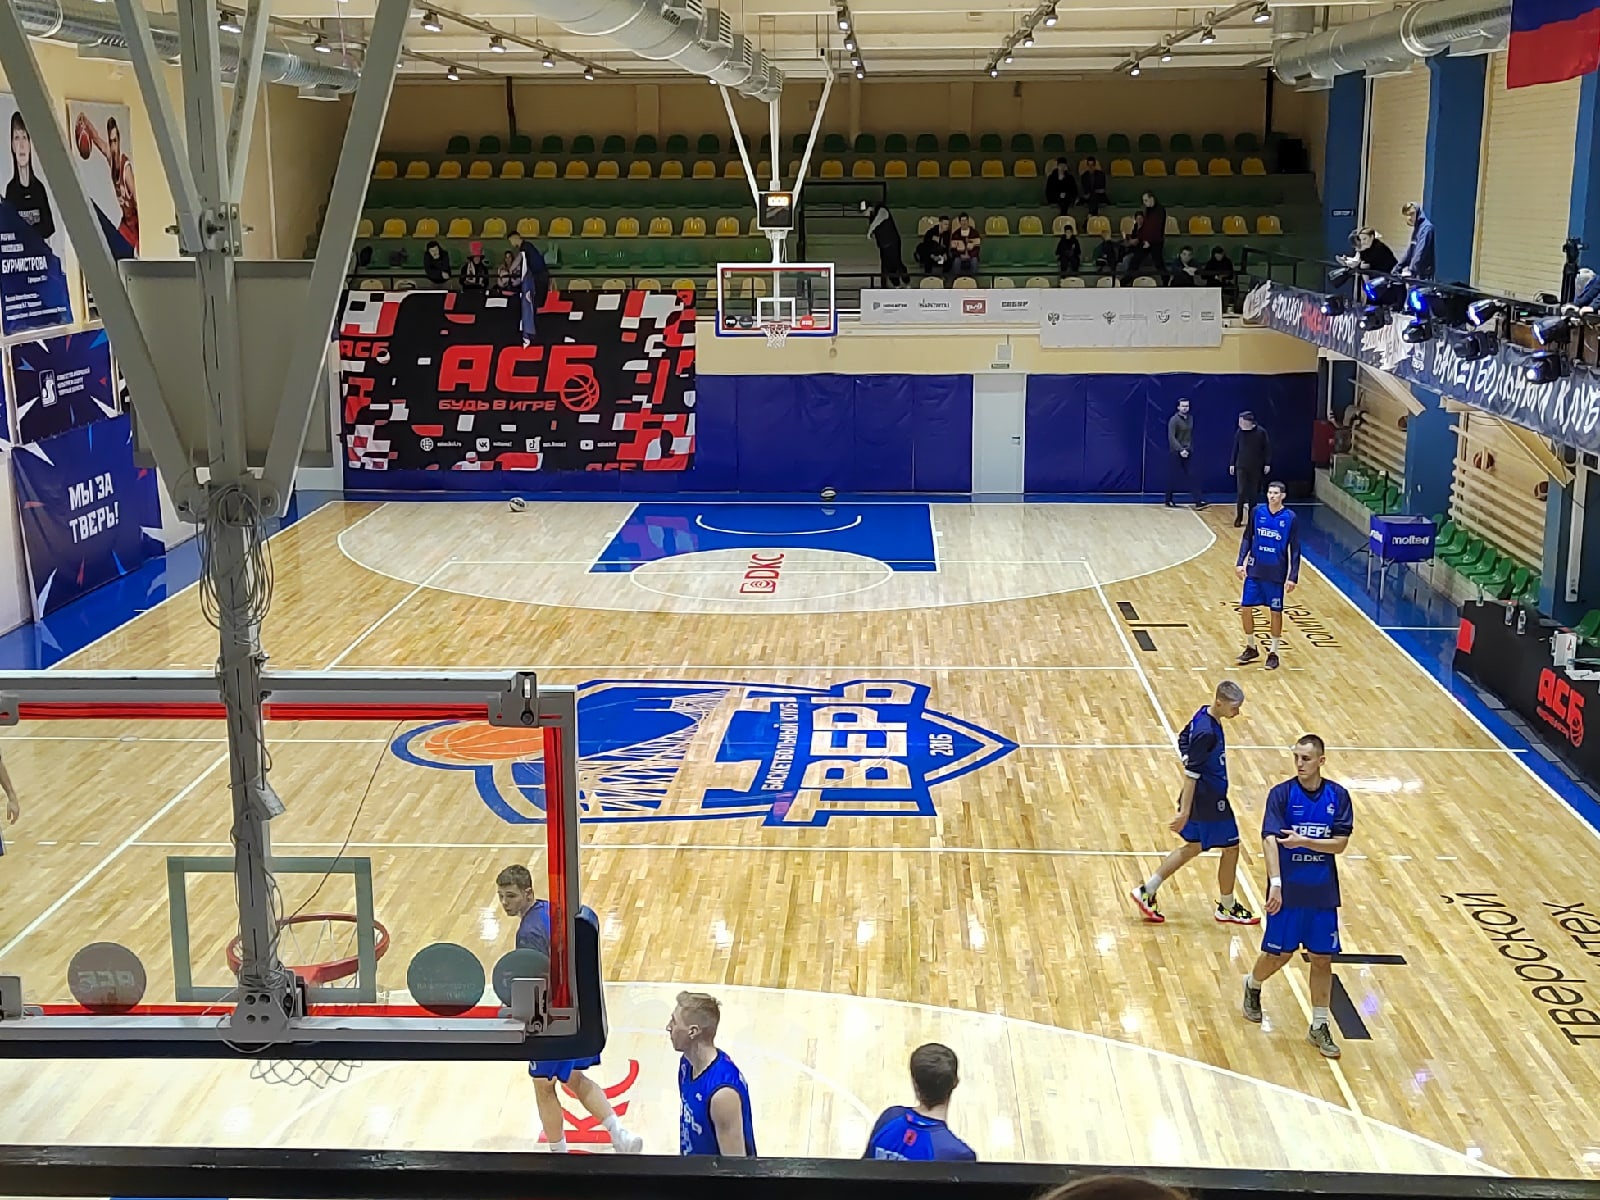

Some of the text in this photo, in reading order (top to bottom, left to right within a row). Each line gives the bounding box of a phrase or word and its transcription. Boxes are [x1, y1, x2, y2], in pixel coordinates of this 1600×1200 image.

[2, 256, 48, 273] БУРМИСТРОВА
[438, 345, 599, 402] АСБ
[439, 400, 557, 411] БУДЬ В ИГРЕ
[68, 472, 114, 511] МЫ ЗА
[69, 502, 119, 544] ТВЕРЬ!
[1392, 535, 1430, 545] molten
[1537, 668, 1585, 747] АСБ
[761, 703, 799, 790] БАСКЕТБОЛЬНЫЙ КЛУБ
[783, 680, 921, 823] ТВЕРЬ
